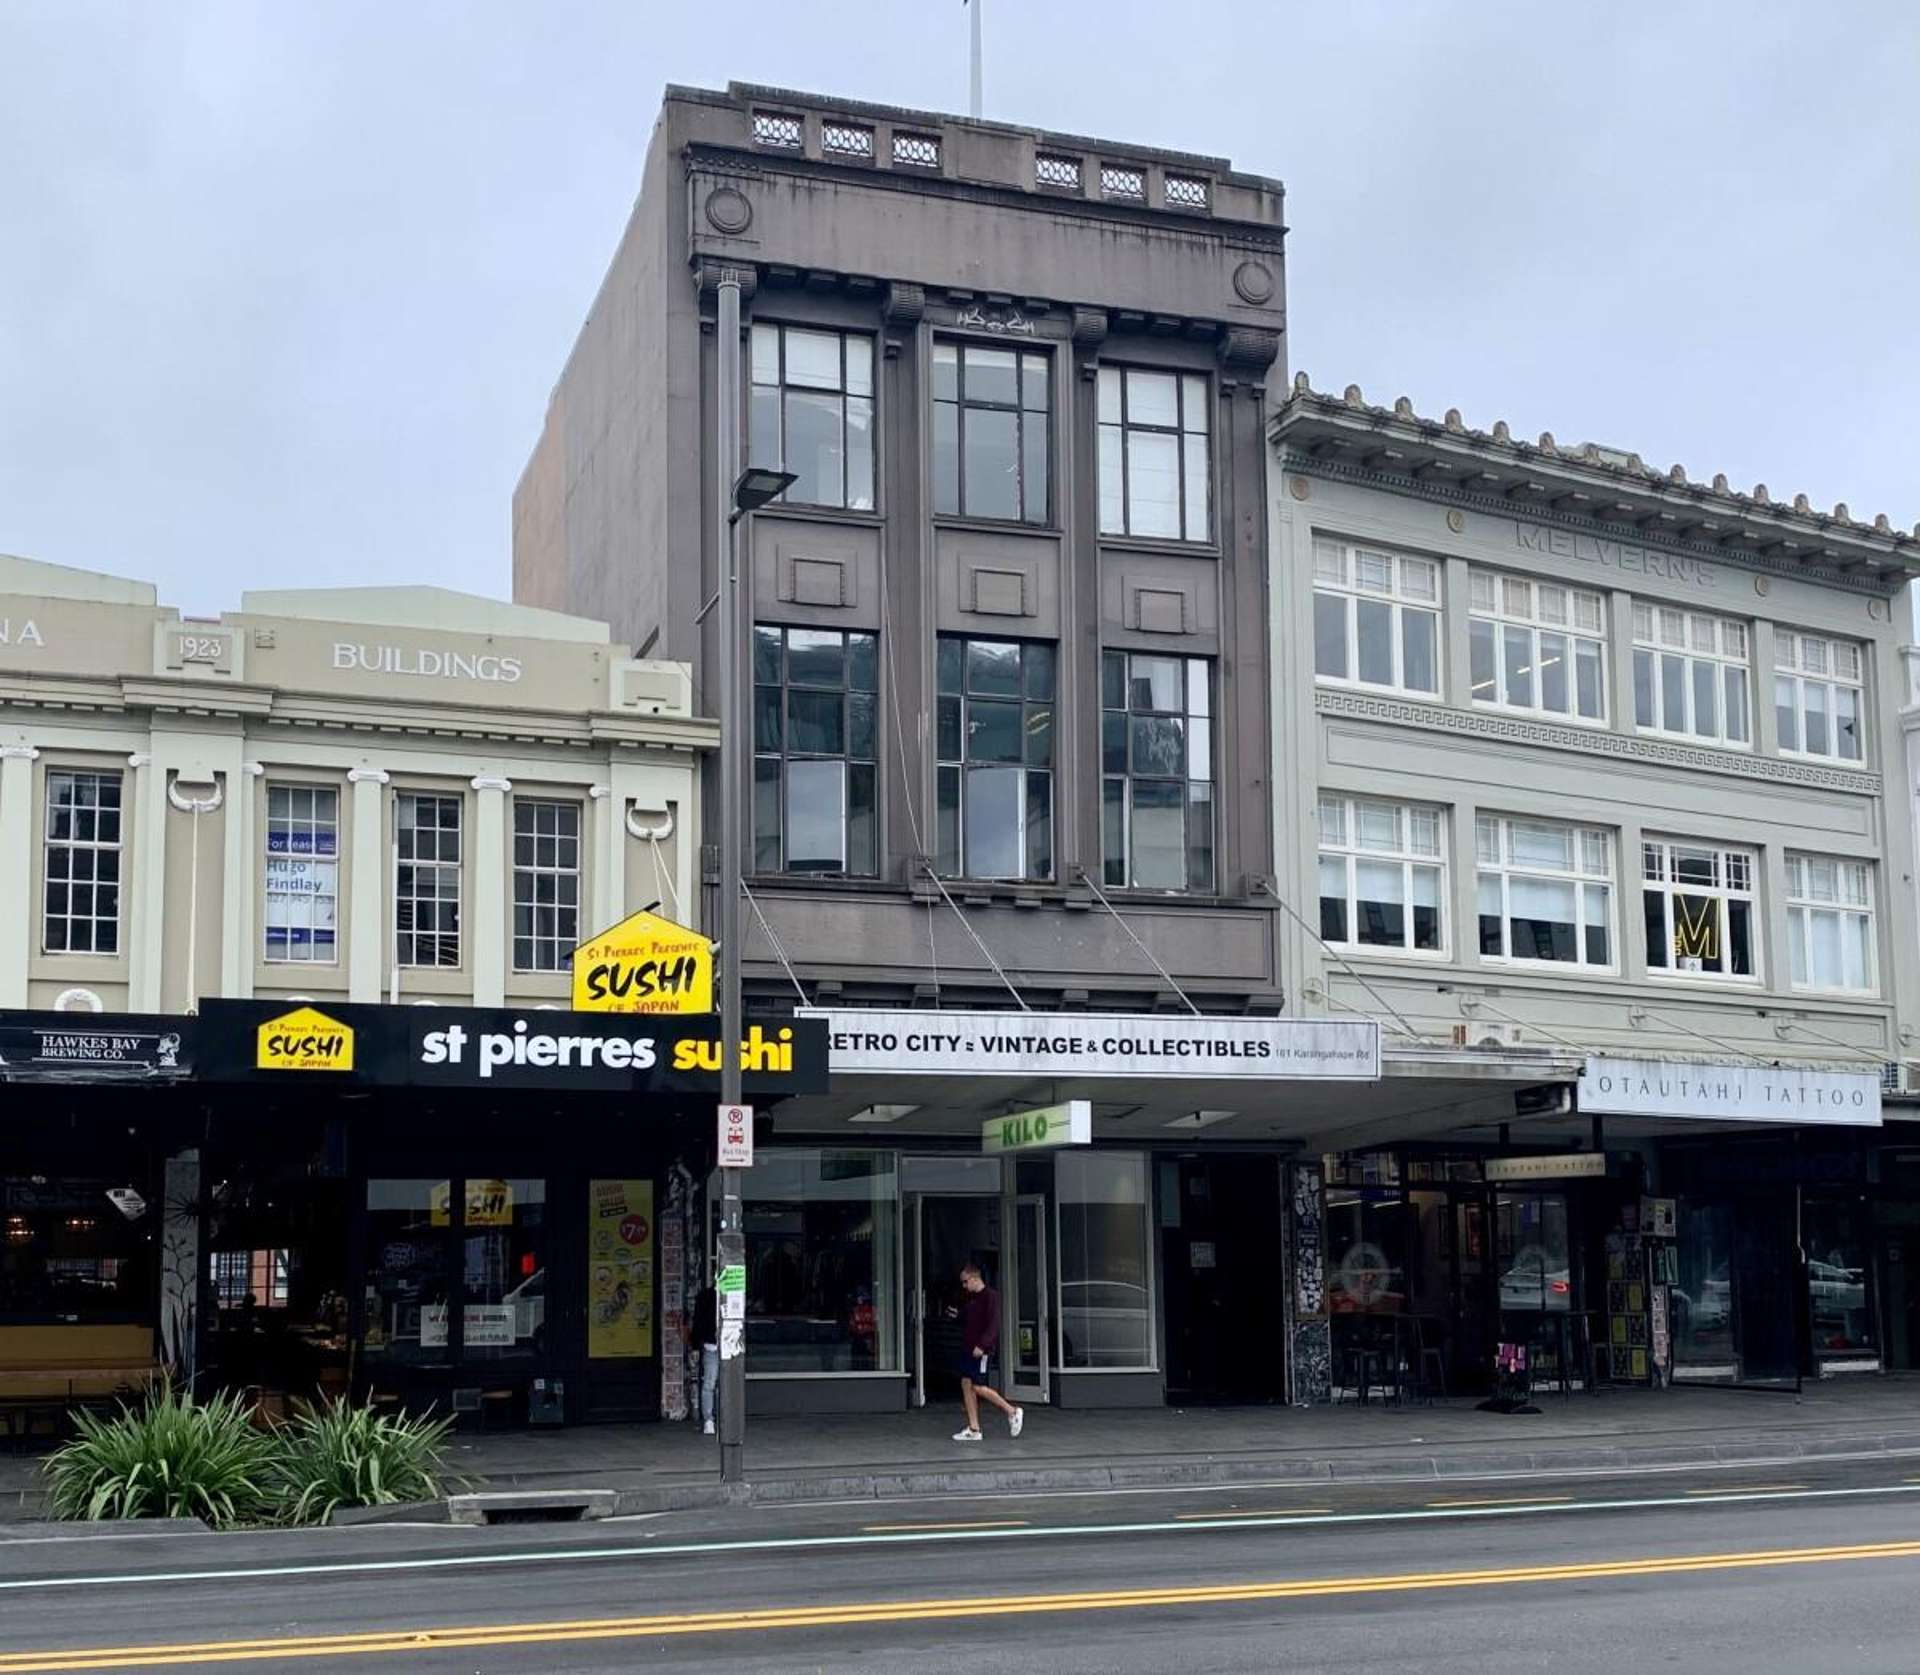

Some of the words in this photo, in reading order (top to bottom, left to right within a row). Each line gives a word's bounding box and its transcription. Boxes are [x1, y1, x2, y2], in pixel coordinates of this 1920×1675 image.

[178, 635, 222, 658] 1923
[332, 642, 523, 683] BUILDINGS
[267, 861, 306, 876] Hugo
[267, 878, 322, 893] Findlay
[586, 956, 697, 1001] SUSHI
[633, 1000, 680, 1013] JAPAN
[42, 1035, 109, 1049] HAWKES
[112, 1038, 141, 1050] BAY
[42, 1047, 102, 1058] BREWING
[103, 1049, 126, 1060] CO.
[268, 1034, 345, 1058] SUSHI
[421, 1025, 467, 1063] st
[479, 1020, 656, 1077] pierres
[906, 1034, 962, 1052] CITY
[980, 1036, 1083, 1054] VINTAGE
[1087, 1040, 1098, 1053] &
[1102, 1037, 1271, 1057] COLLECTIBLES
[1599, 1075, 1743, 1101] OTAUTAHI
[1764, 1085, 1864, 1106] TATTOO
[1002, 1115, 1048, 1148] KILO
